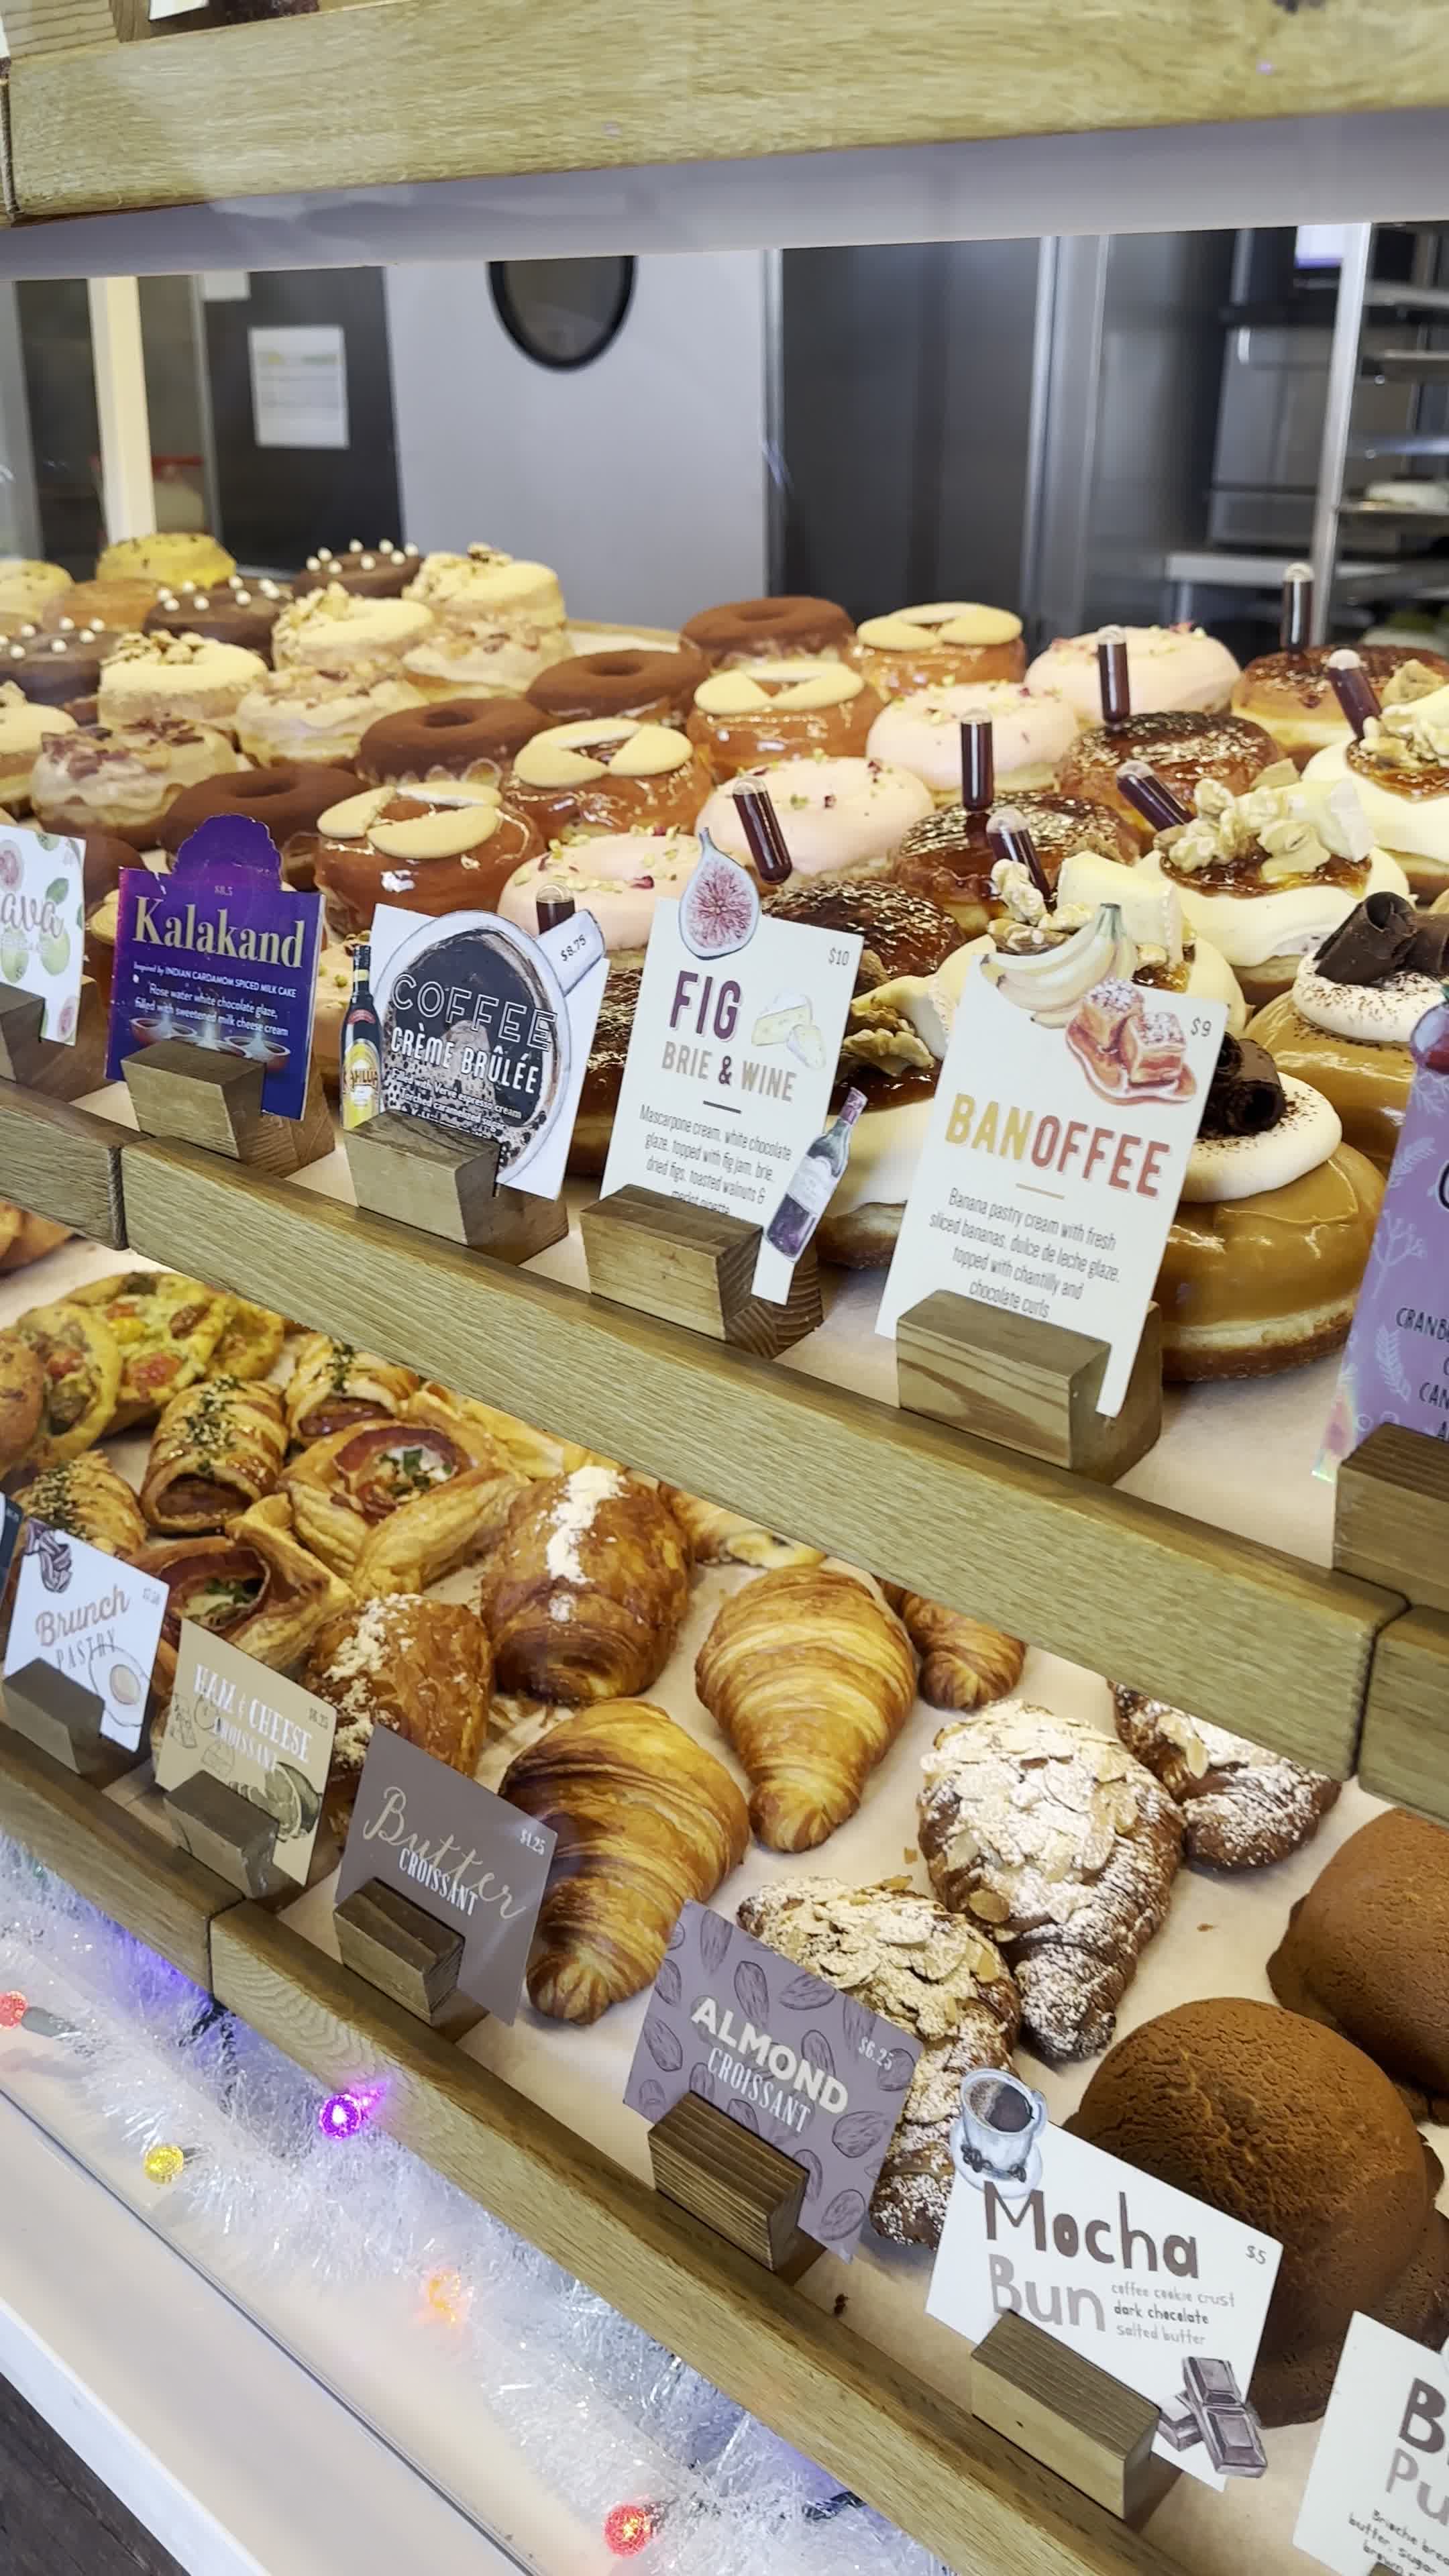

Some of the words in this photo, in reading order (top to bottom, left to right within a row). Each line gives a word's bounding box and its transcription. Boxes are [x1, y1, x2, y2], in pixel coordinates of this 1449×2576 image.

[132, 896, 305, 968] Kalakand
[560, 934, 586, 961] $8.75
[828, 947, 850, 966] $10
[149, 981, 170, 998] Rose
[170, 989, 193, 1002] water
[193, 993, 215, 1006] white
[217, 996, 255, 1014] chocolate
[165, 966, 192, 979] INDIAN
[192, 971, 234, 987] CARDAMOM
[235, 979, 260, 991] SPICED
[260, 983, 276, 994] MILK
[278, 986, 297, 998] CAKE
[669, 970, 741, 1042] FIG
[157, 1002, 174, 1014] with
[176, 1008, 217, 1022] sweetened
[217, 1014, 235, 1026] milk
[236, 1016, 264, 1032] cheese
[264, 1024, 289, 1036] cream
[390, 972, 557, 1053] COFFEE
[1189, 1016, 1212, 1037] $9
[390, 1022, 455, 1069] CRÈME
[461, 1045, 539, 1094] BRÛLÉE
[661, 1040, 712, 1079] BRIE
[718, 1055, 732, 1085] &
[741, 1060, 797, 1102] WINE
[400, 1087, 433, 1108] Torched
[415, 1077, 433, 1091] with
[434, 1081, 458, 1099] Verve
[458, 1093, 494, 1110] espresso
[495, 1105, 523, 1120] cream
[639, 1104, 692, 1132] Mascarpone
[724, 1128, 747, 1148] white
[749, 1136, 792, 1161] chocolate
[672, 1140, 702, 1161] topped
[703, 1149, 722, 1166] with
[722, 1152, 734, 1173] fig
[945, 1093, 1171, 1198] BANOFFEE
[646, 1155, 669, 1175] dried
[689, 1170, 722, 1191] toasted
[723, 1181, 757, 1202] walnuts
[757, 1187, 766, 1205] &
[928, 1210, 961, 1234] sliced
[1010, 1234, 1040, 1258] dulce
[1041, 1242, 1056, 1263] de
[1057, 1247, 1087, 1273] leche
[949, 1187, 988, 1214] Banana
[989, 1202, 1023, 1228] pastry
[1024, 1212, 1059, 1235] cream
[1060, 1222, 1084, 1242] with
[1085, 1226, 1116, 1251] fresh
[952, 1245, 990, 1271] topped
[990, 1258, 1013, 1278] with
[1013, 1264, 1061, 1296] chantilly
[1061, 1281, 1085, 1300] and
[969, 1279, 1020, 1309] chocolate
[1021, 1297, 1051, 1318] curls
[36, 1583, 130, 1648] Brunch
[56, 1626, 115, 1670] PASTRY
[194, 1663, 236, 1713] HAM
[249, 1698, 312, 1764] CHEESE
[363, 1786, 527, 1920] Butter
[398, 1847, 479, 1917] CROISSANT
[690, 1996, 849, 2114] ALMOND
[859, 2036, 894, 2071] $6.25
[707, 2046, 811, 2133] CROISSANT
[983, 2180, 1199, 2279] Mocha
[1245, 2245, 1267, 2265] $5
[989, 2253, 1106, 2332] Bun
[1111, 2282, 1150, 2298] coffee
[1154, 2286, 1193, 2302] cookie
[1197, 2292, 1235, 2308] crust
[1114, 2300, 1144, 2318] dark
[1148, 2303, 1210, 2324] chocolate
[1116, 2322, 1159, 2340] salted
[1162, 2326, 1206, 2345] butter
[1373, 2508, 1417, 2545] Brioche
